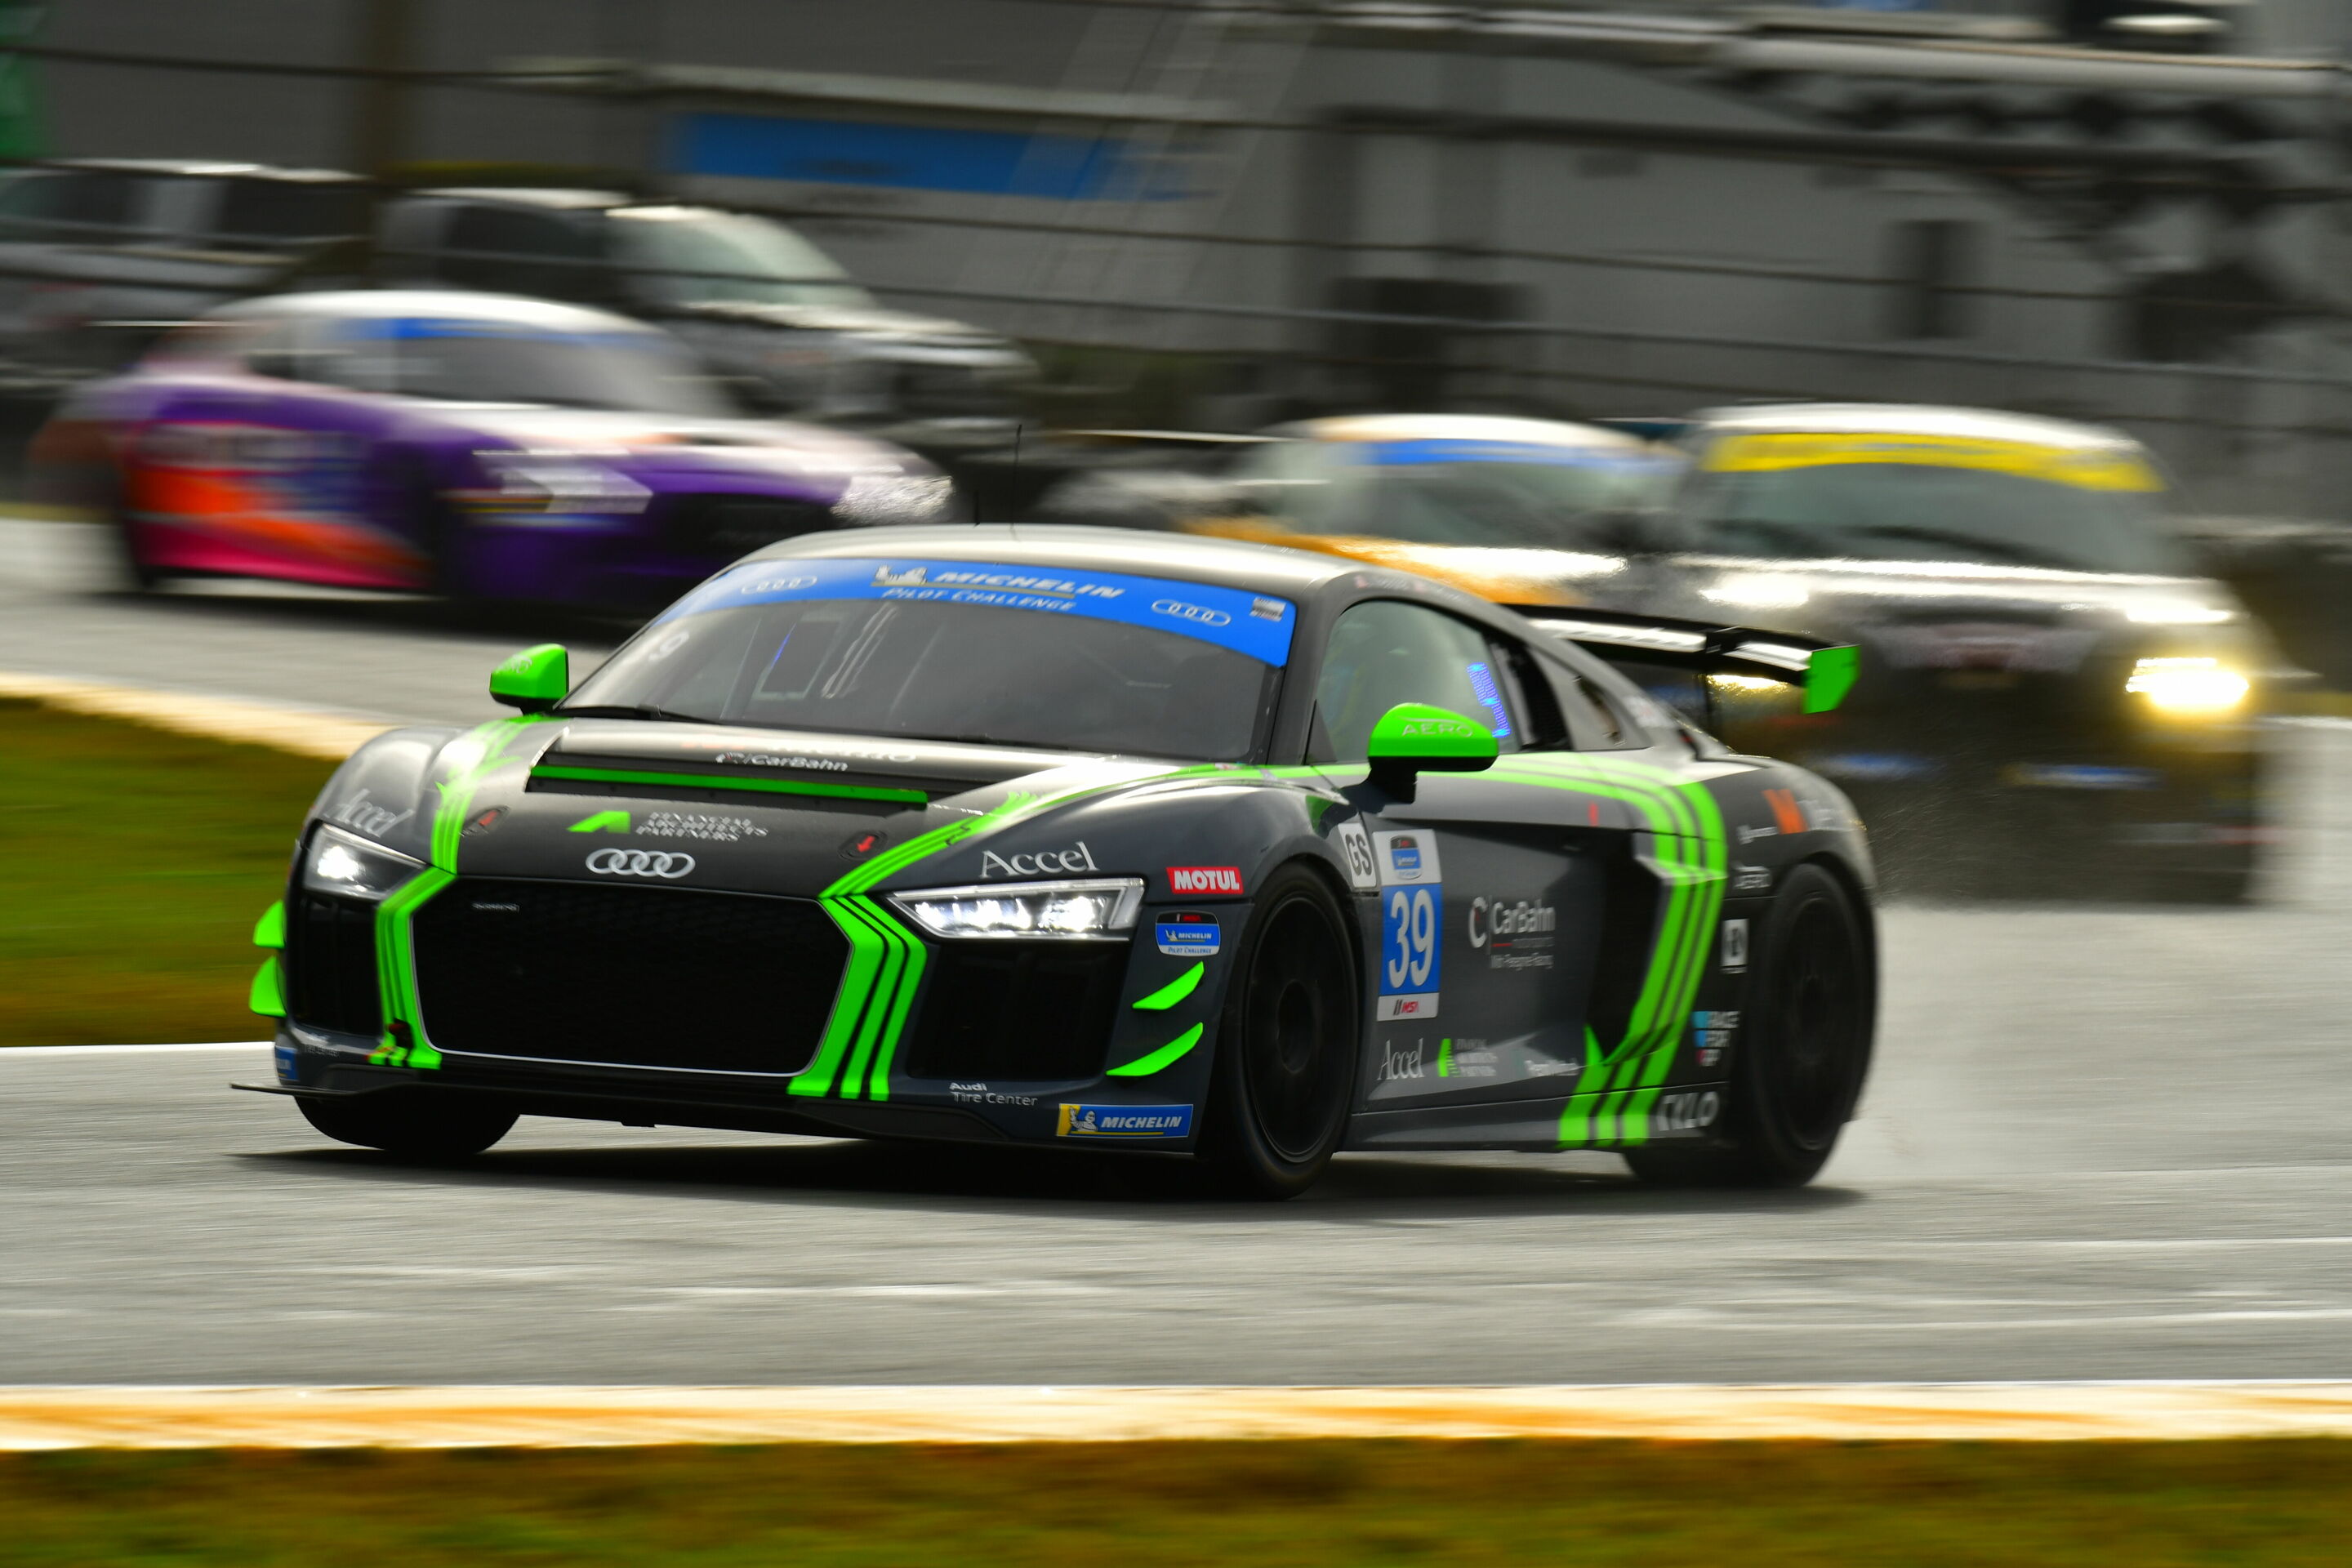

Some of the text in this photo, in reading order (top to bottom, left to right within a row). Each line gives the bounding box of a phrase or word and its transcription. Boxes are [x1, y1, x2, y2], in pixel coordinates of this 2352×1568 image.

[933, 572, 1125, 599] MICHELIN
[881, 587, 1077, 612] PILOT CHALLENGE
[751, 754, 849, 772] CarBahn
[978, 840, 1101, 879] Accel
[1345, 833, 1372, 876] GS
[1174, 870, 1240, 890] MOTUL
[1491, 899, 1556, 934] CarBahn
[1178, 932, 1212, 940] MICHELIN
[1388, 889, 1435, 988] 39
[1377, 1038, 1425, 1080] Accel
[949, 1082, 987, 1091] Audi
[951, 1091, 1038, 1107] Tire Center
[1101, 1116, 1183, 1128] MICHELIN
